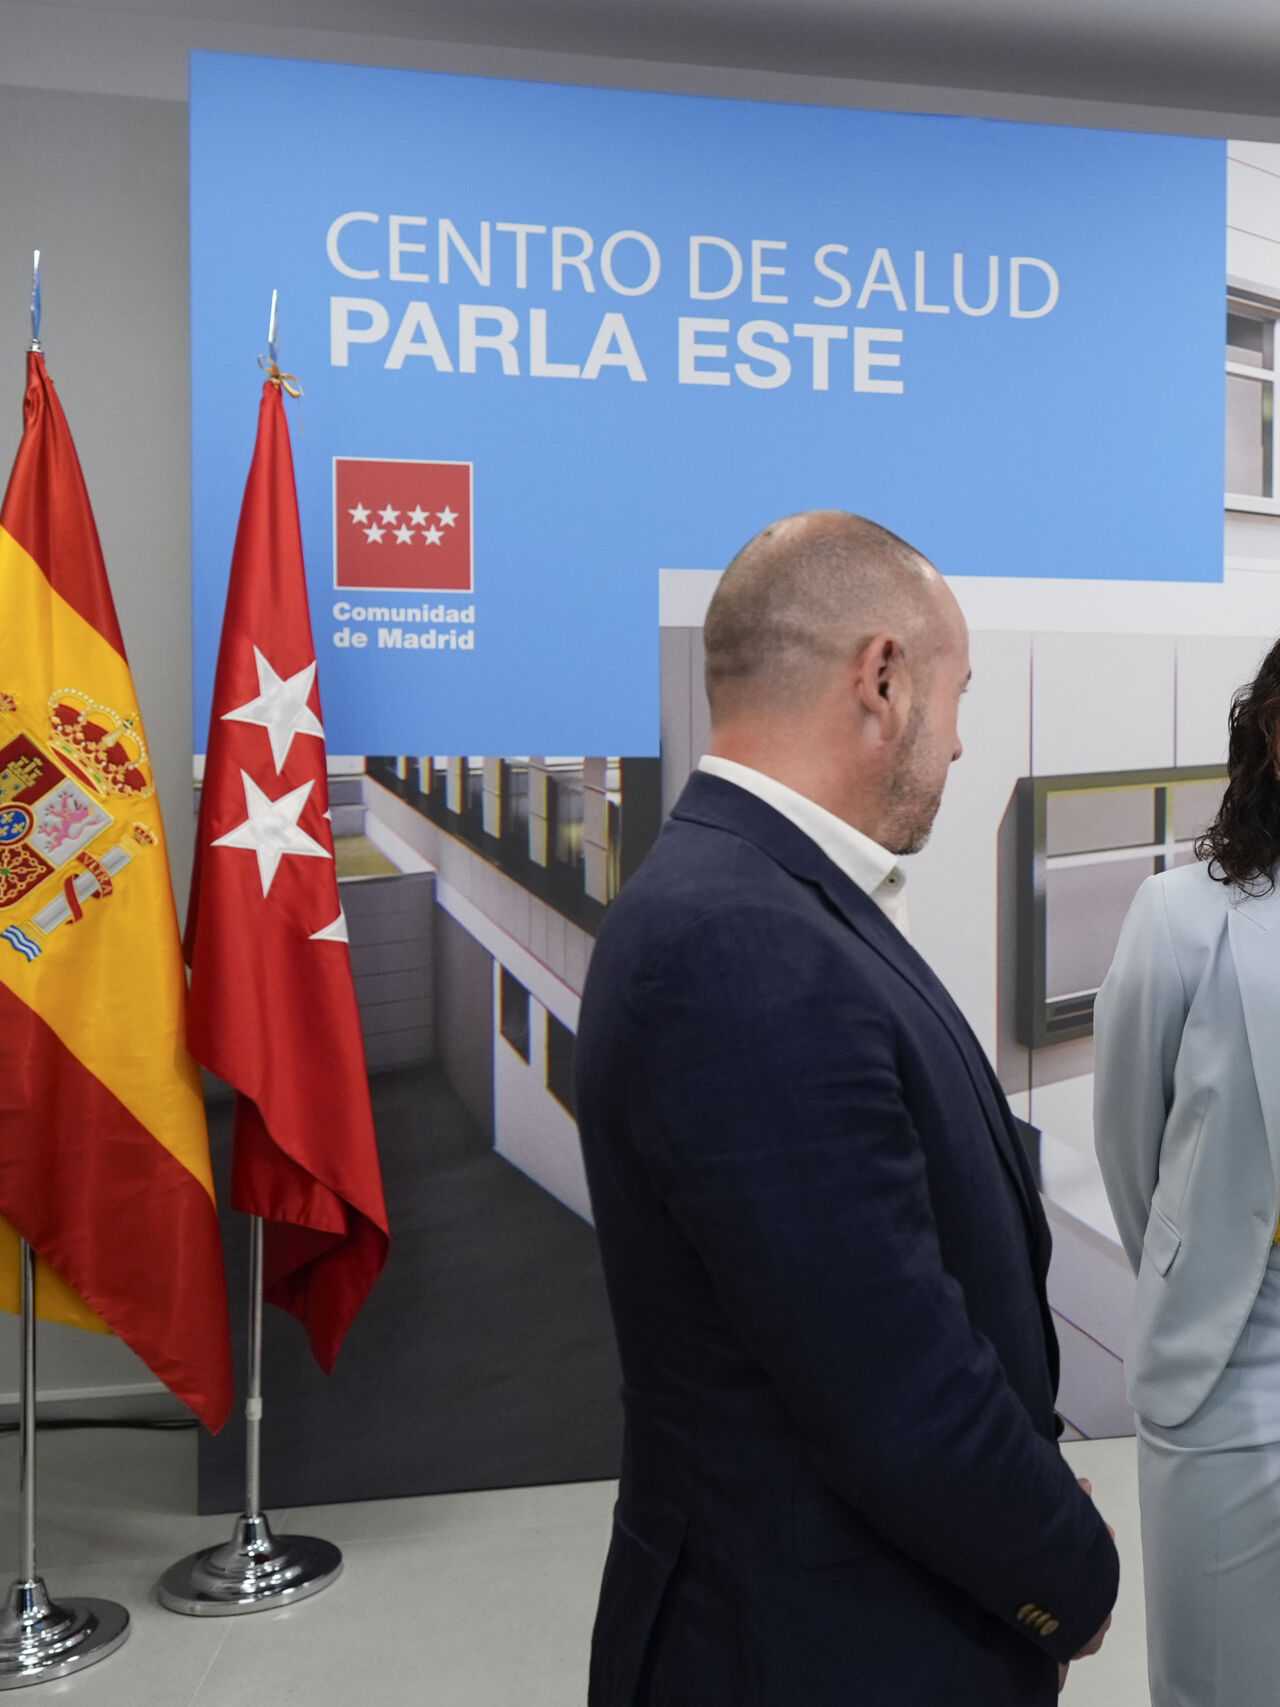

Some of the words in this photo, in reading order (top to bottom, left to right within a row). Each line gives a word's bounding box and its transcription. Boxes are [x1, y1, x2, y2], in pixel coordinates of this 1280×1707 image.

[326, 211, 661, 297] CENTRO
[689, 235, 788, 305] DE
[813, 244, 1060, 319] SALUD
[330, 296, 648, 382] PARLA
[678, 316, 904, 395] ESTE
[333, 602, 475, 623] Comunidad
[333, 627, 368, 648] de
[378, 628, 475, 650] Madrid
